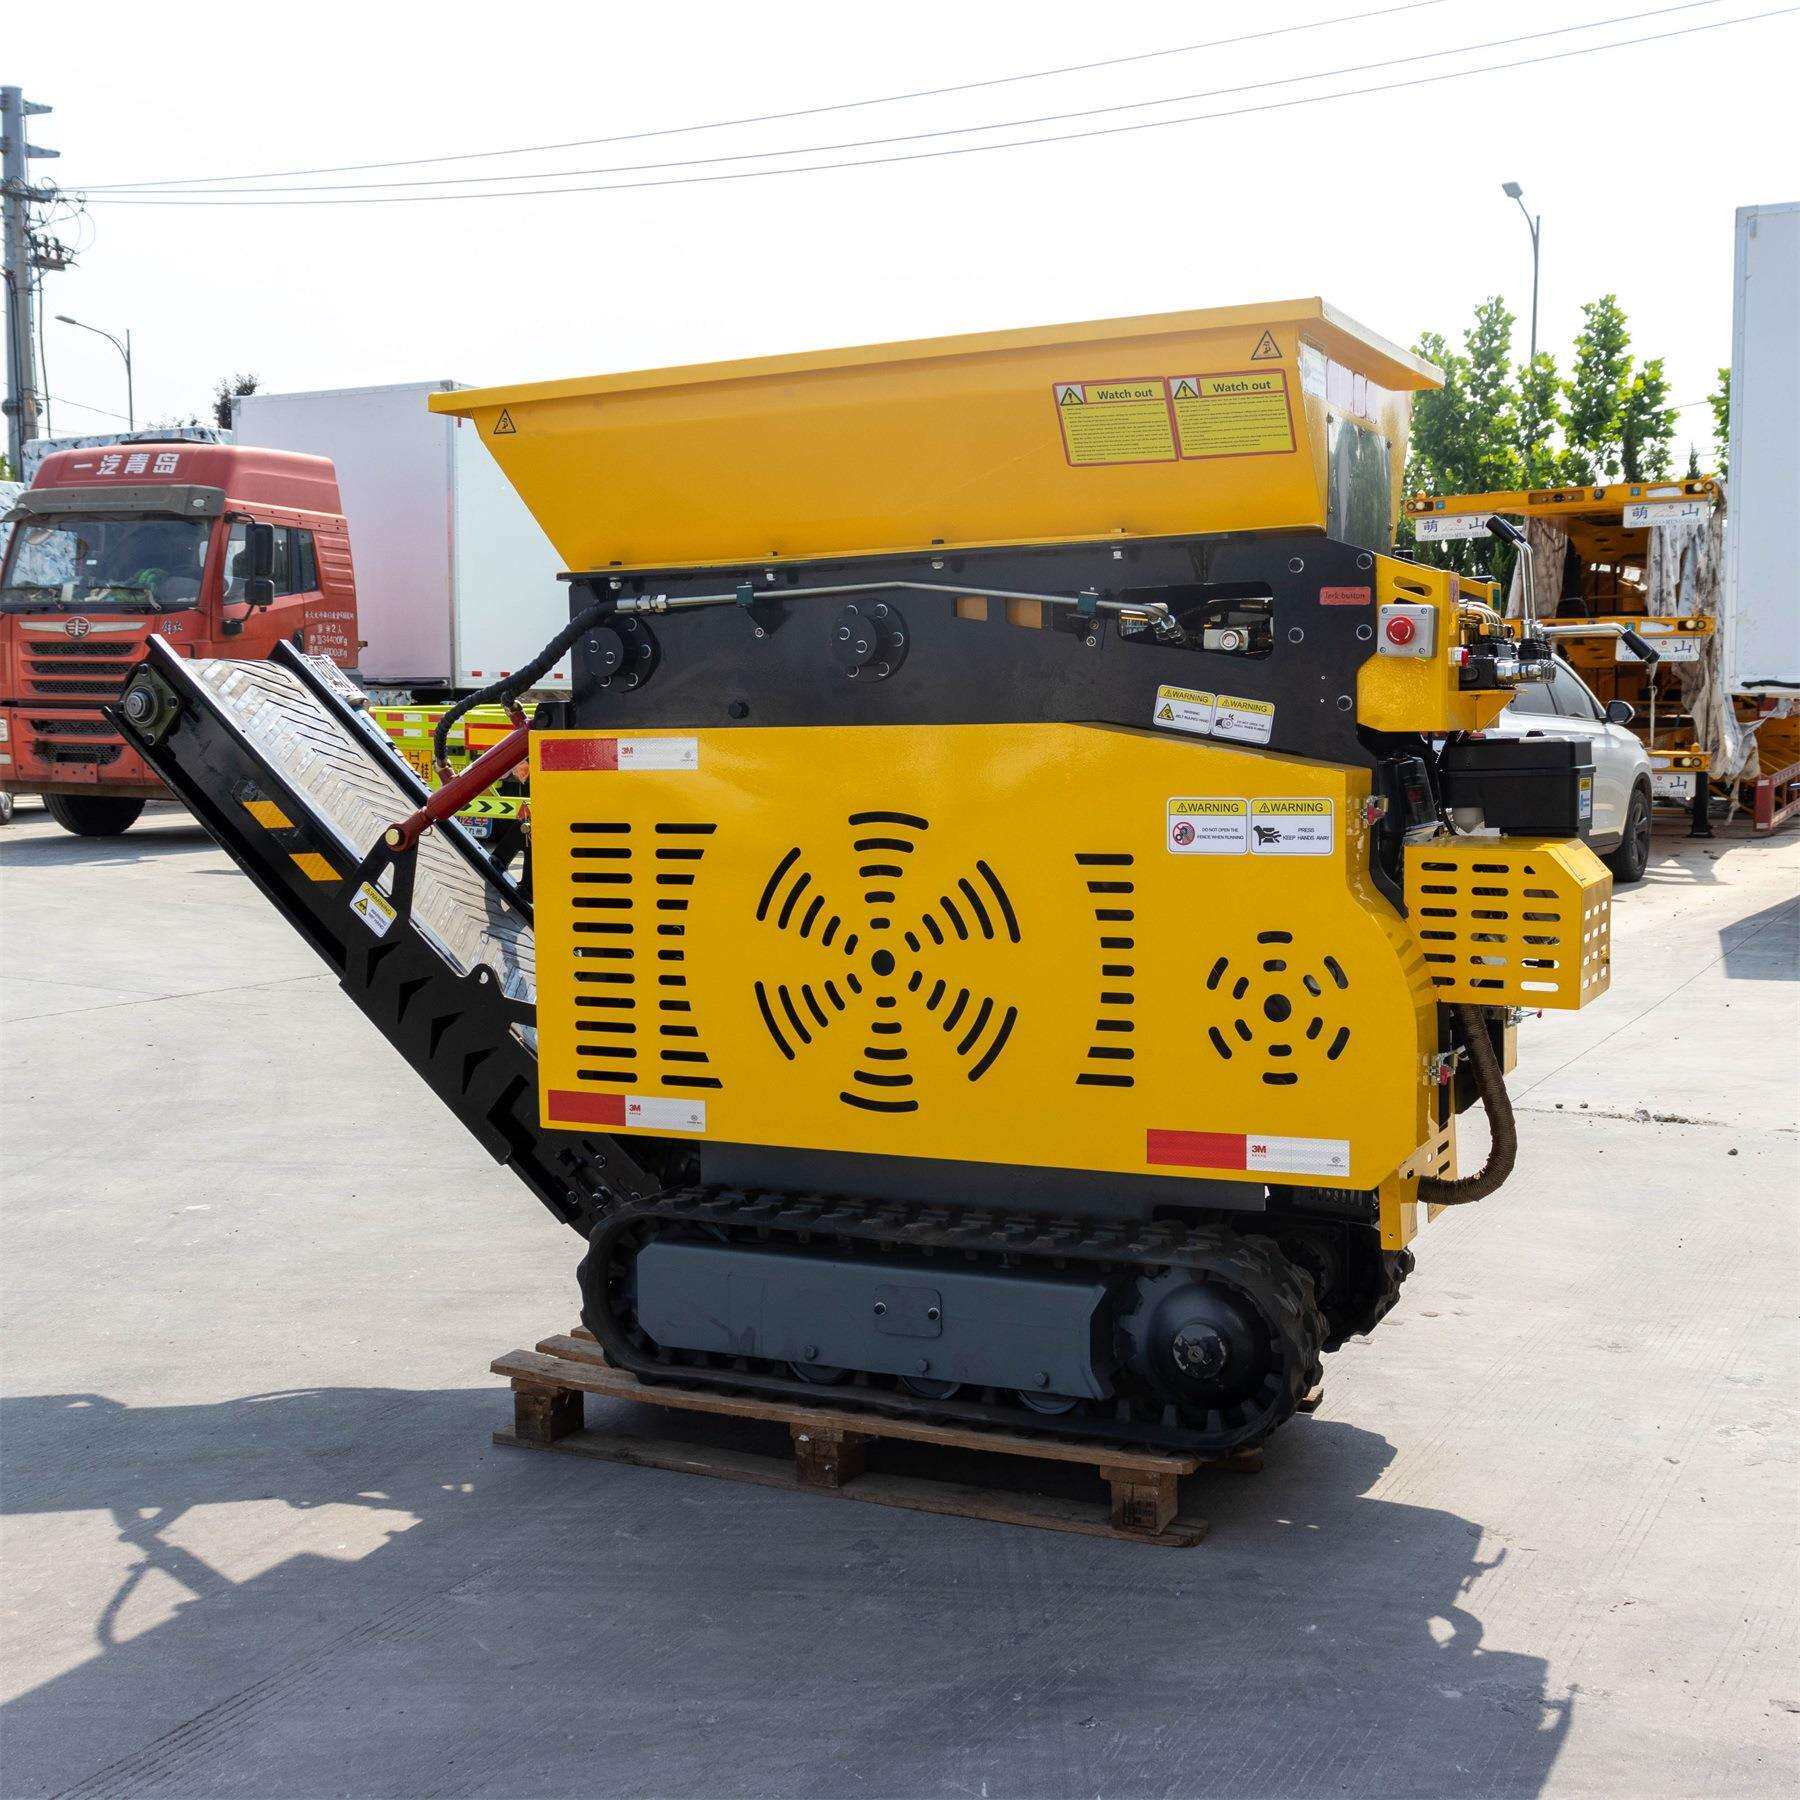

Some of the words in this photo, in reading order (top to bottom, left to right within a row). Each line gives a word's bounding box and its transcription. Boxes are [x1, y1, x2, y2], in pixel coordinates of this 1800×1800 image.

[1212, 381, 1249, 393] Watch
[1251, 380, 1271, 390] out
[1097, 389, 1132, 400] Watch
[1134, 388, 1154, 398] out
[73, 453, 180, 476] 一汽青岛
[1681, 503, 1699, 517] 山
[1468, 517, 1486, 530] 山
[1673, 640, 1692, 653] 山
[1172, 690, 1209, 704] WARNING
[1229, 700, 1267, 713] WARNING
[621, 746, 634, 755] 3M
[1187, 803, 1239, 813] WARNING
[1270, 803, 1324, 812] WARNING
[629, 1104, 642, 1113] 3M
[1251, 1145, 1267, 1154] 3M
